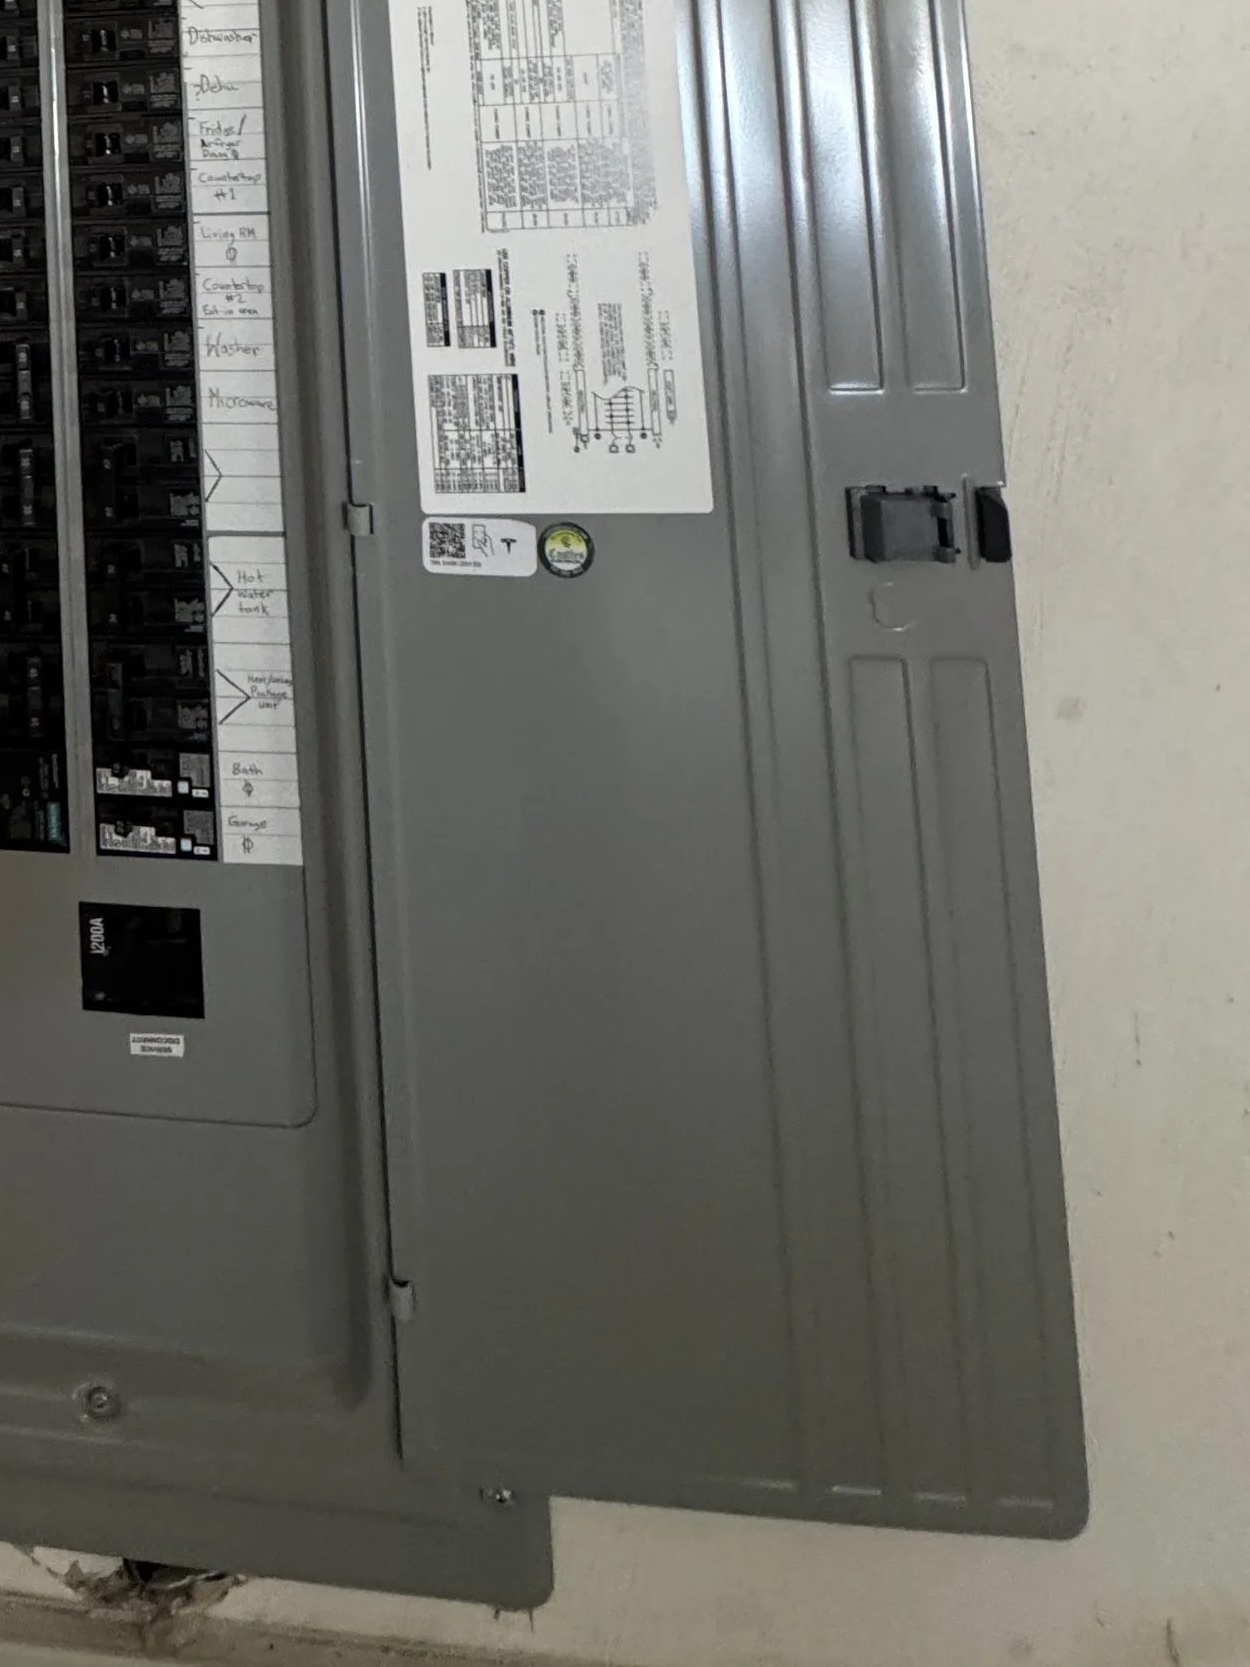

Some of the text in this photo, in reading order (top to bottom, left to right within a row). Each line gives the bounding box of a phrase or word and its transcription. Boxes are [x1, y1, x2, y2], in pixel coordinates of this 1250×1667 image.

[206, 332, 261, 358] Washer
[208, 387, 277, 411] Microwave
[237, 569, 265, 585] Hot
[238, 603, 270, 616] tank
[232, 762, 264, 775] Bath
[227, 815, 268, 831] Garage
